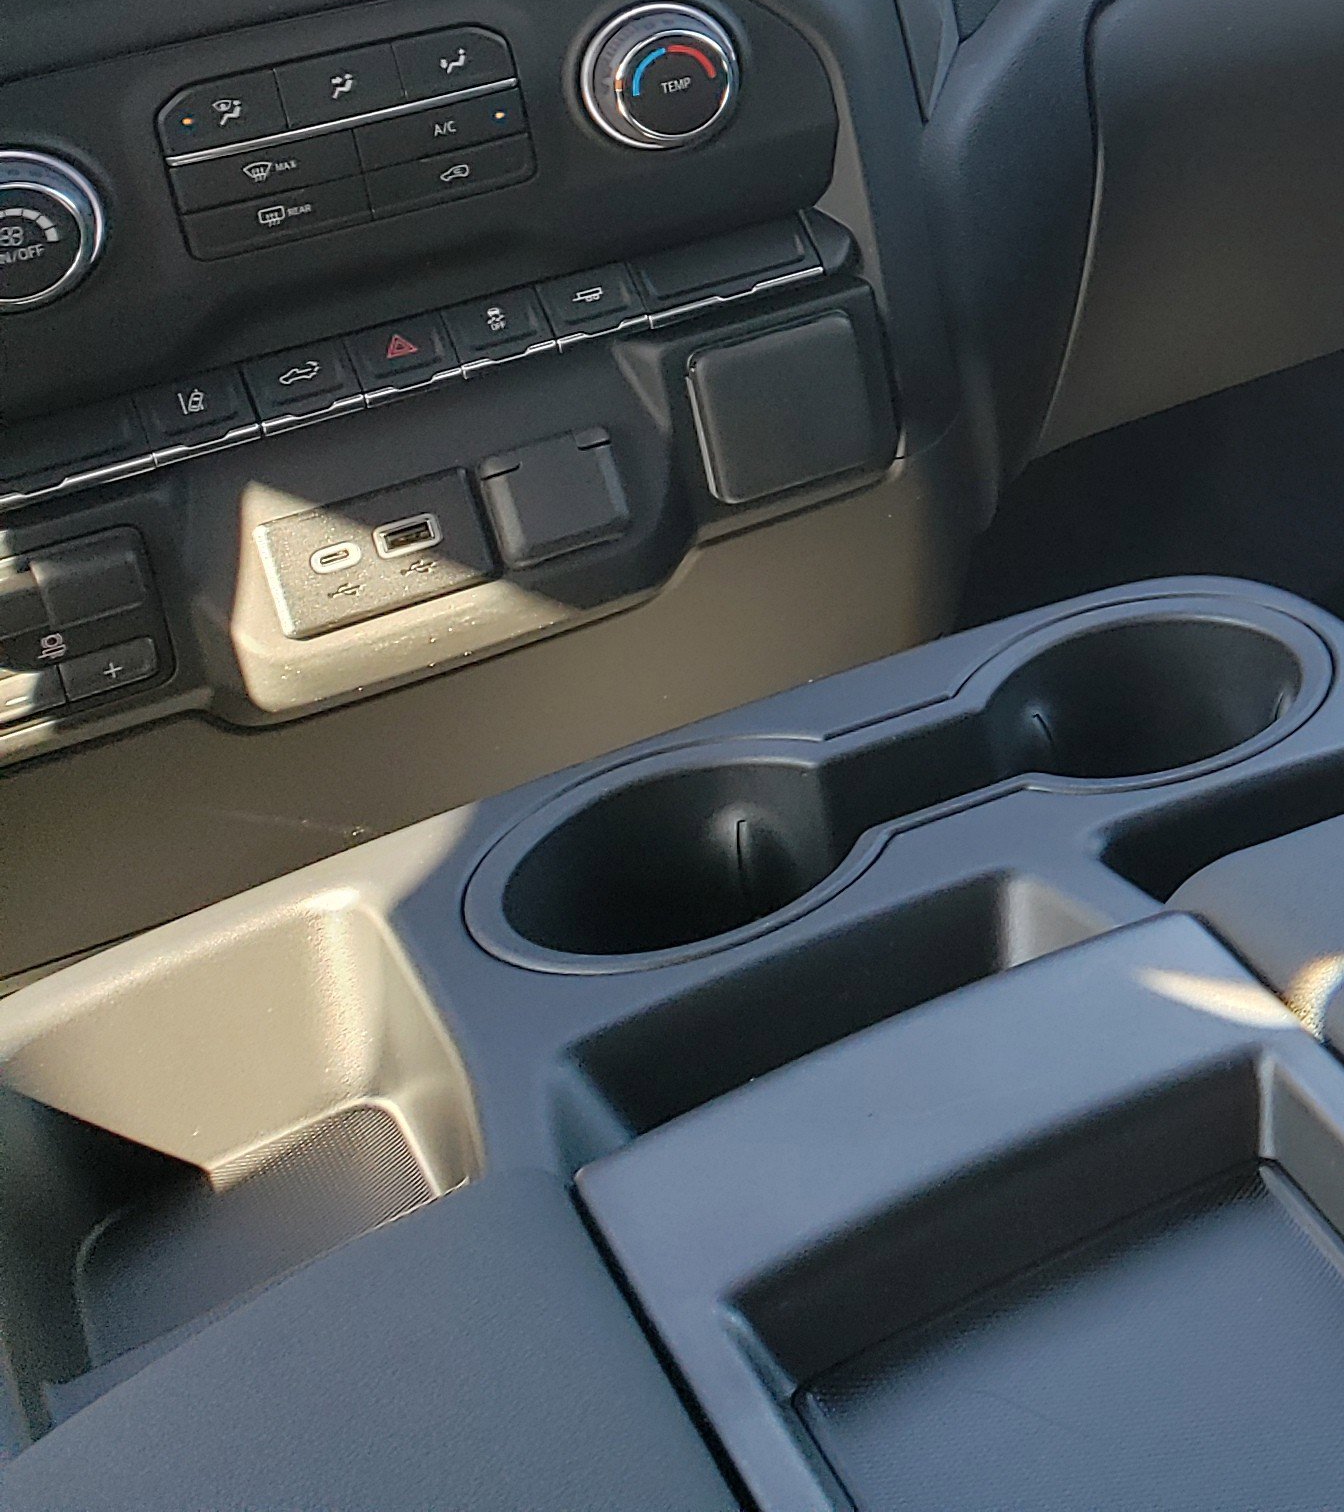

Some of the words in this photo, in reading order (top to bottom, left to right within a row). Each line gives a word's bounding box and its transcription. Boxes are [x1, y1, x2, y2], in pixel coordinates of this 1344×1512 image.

[661, 76, 692, 94] TEMP
[434, 120, 457, 137] A/C
[275, 160, 297, 172] MAX
[287, 204, 312, 218] REAR
[0, 243, 45, 265] N/OFF
